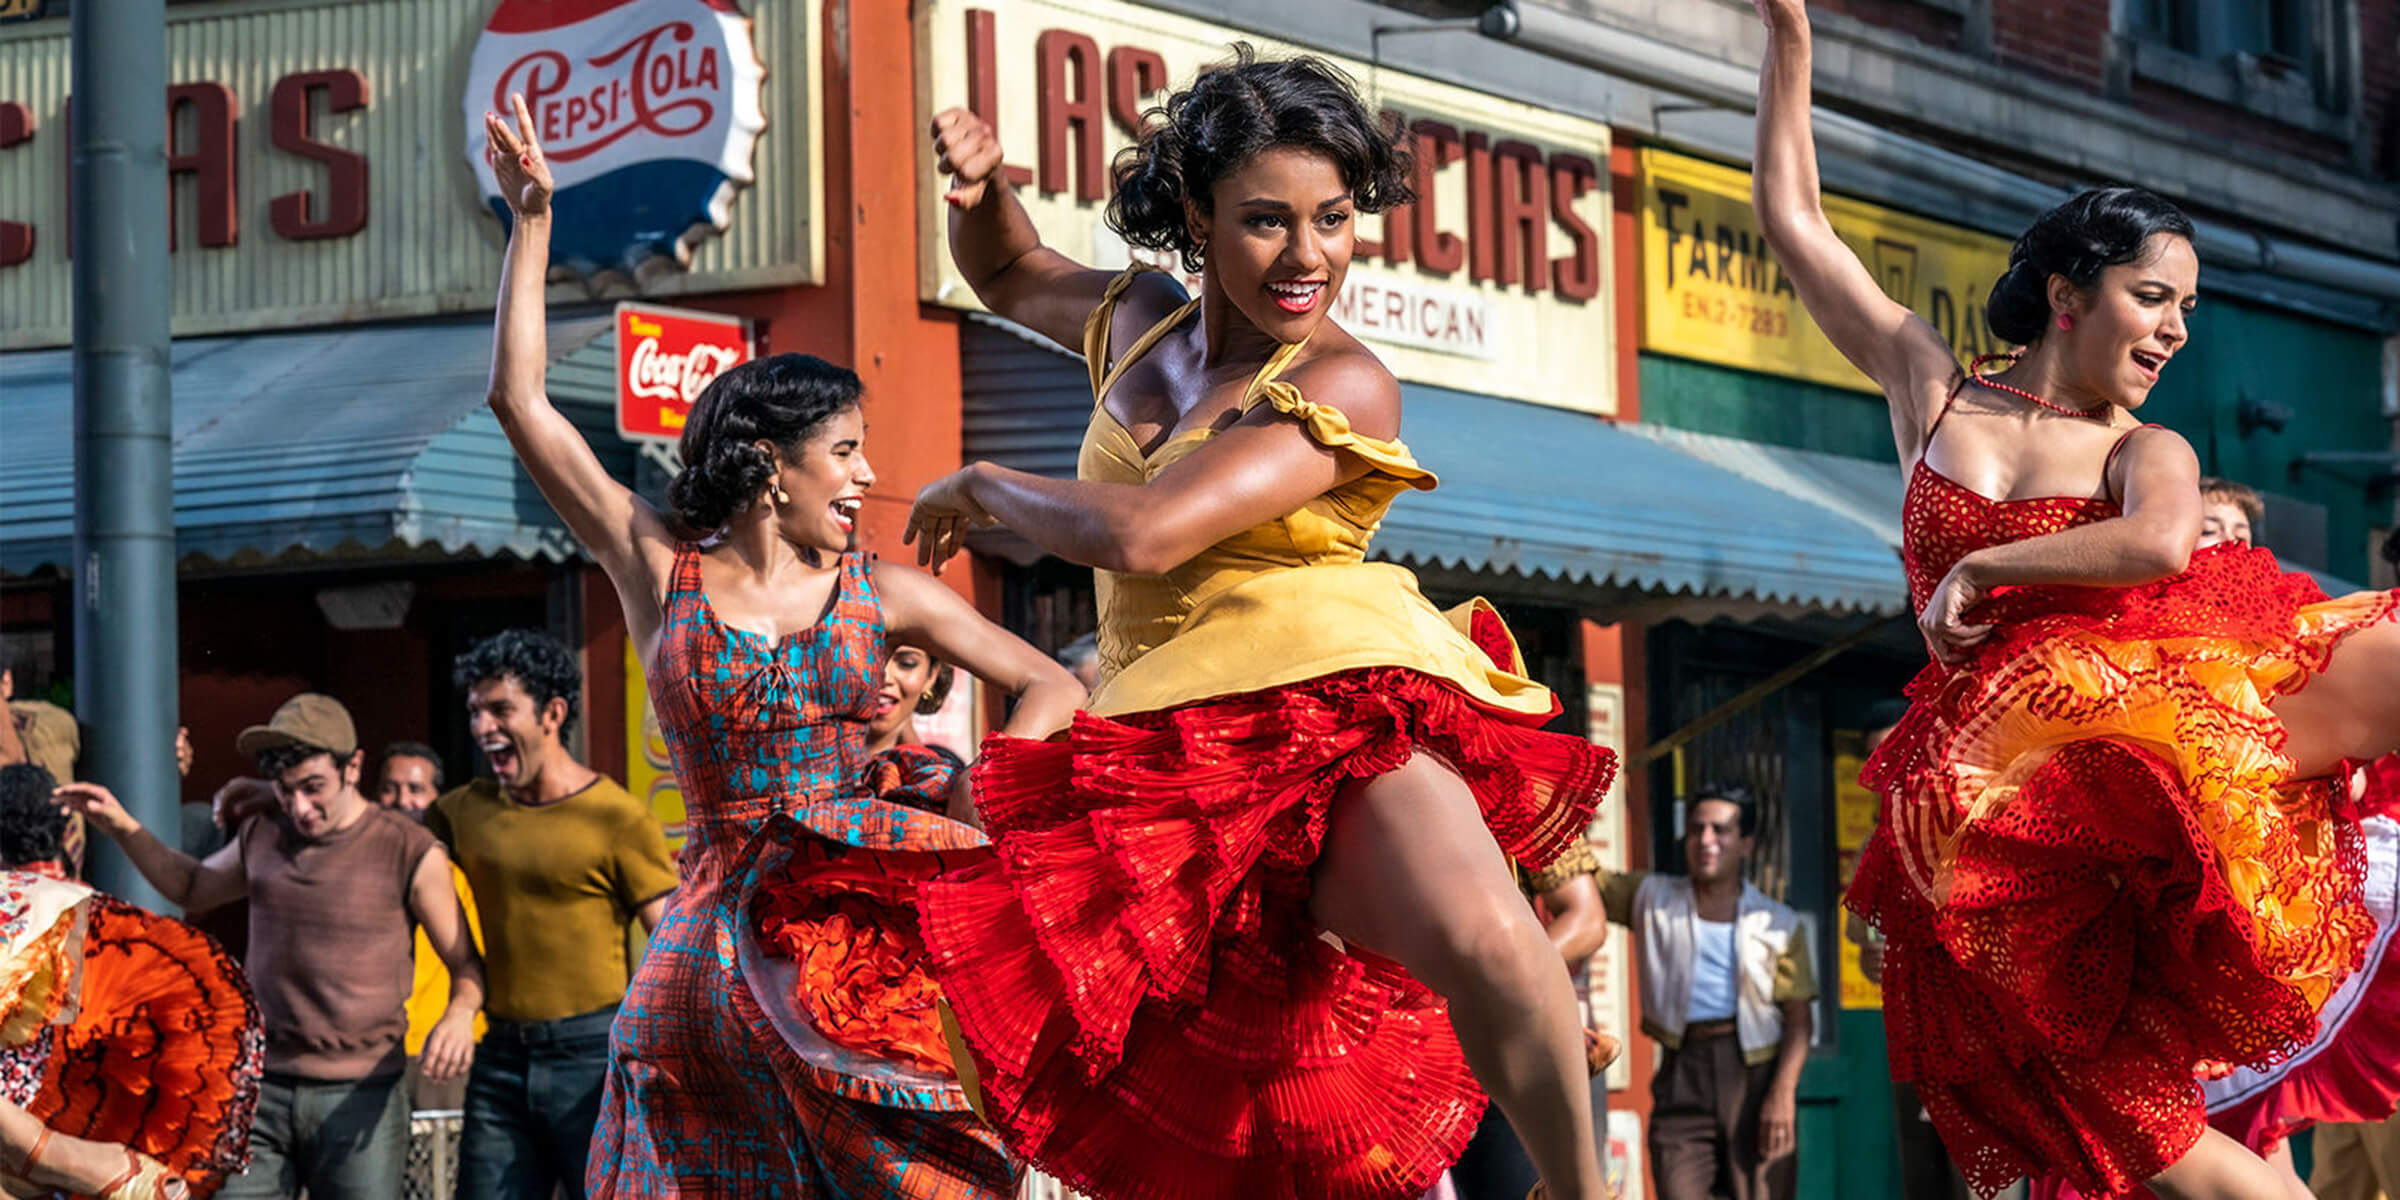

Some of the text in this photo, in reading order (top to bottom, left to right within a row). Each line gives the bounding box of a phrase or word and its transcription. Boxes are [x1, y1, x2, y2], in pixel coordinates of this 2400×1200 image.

[1658, 187, 1796, 303] FARMA
[1335, 284, 1485, 345] MERICAN
[629, 337, 741, 403] Coca-Col
